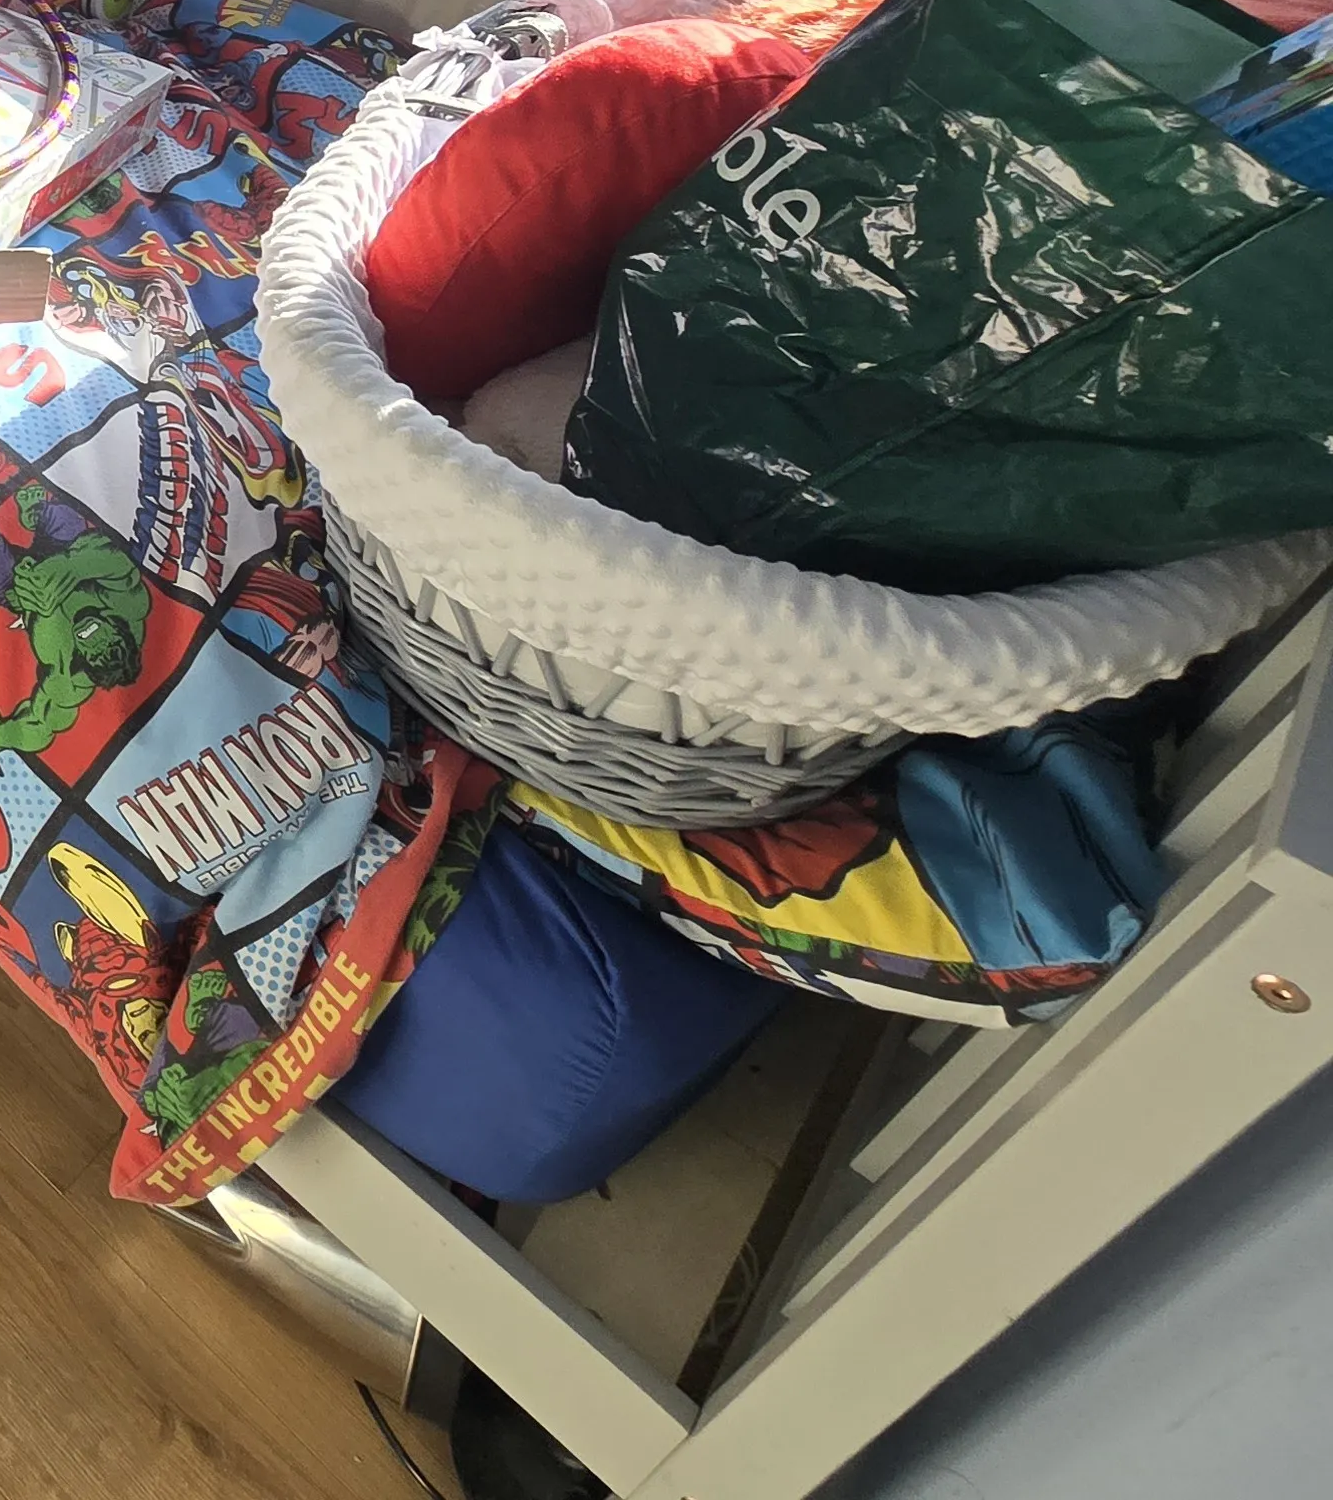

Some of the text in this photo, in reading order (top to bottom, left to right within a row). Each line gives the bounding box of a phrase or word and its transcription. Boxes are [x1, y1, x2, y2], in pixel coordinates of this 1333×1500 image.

[117, 682, 375, 882] IRON MAN
[318, 773, 370, 803] THE
[145, 950, 374, 1198] THE INCREDIBLE
